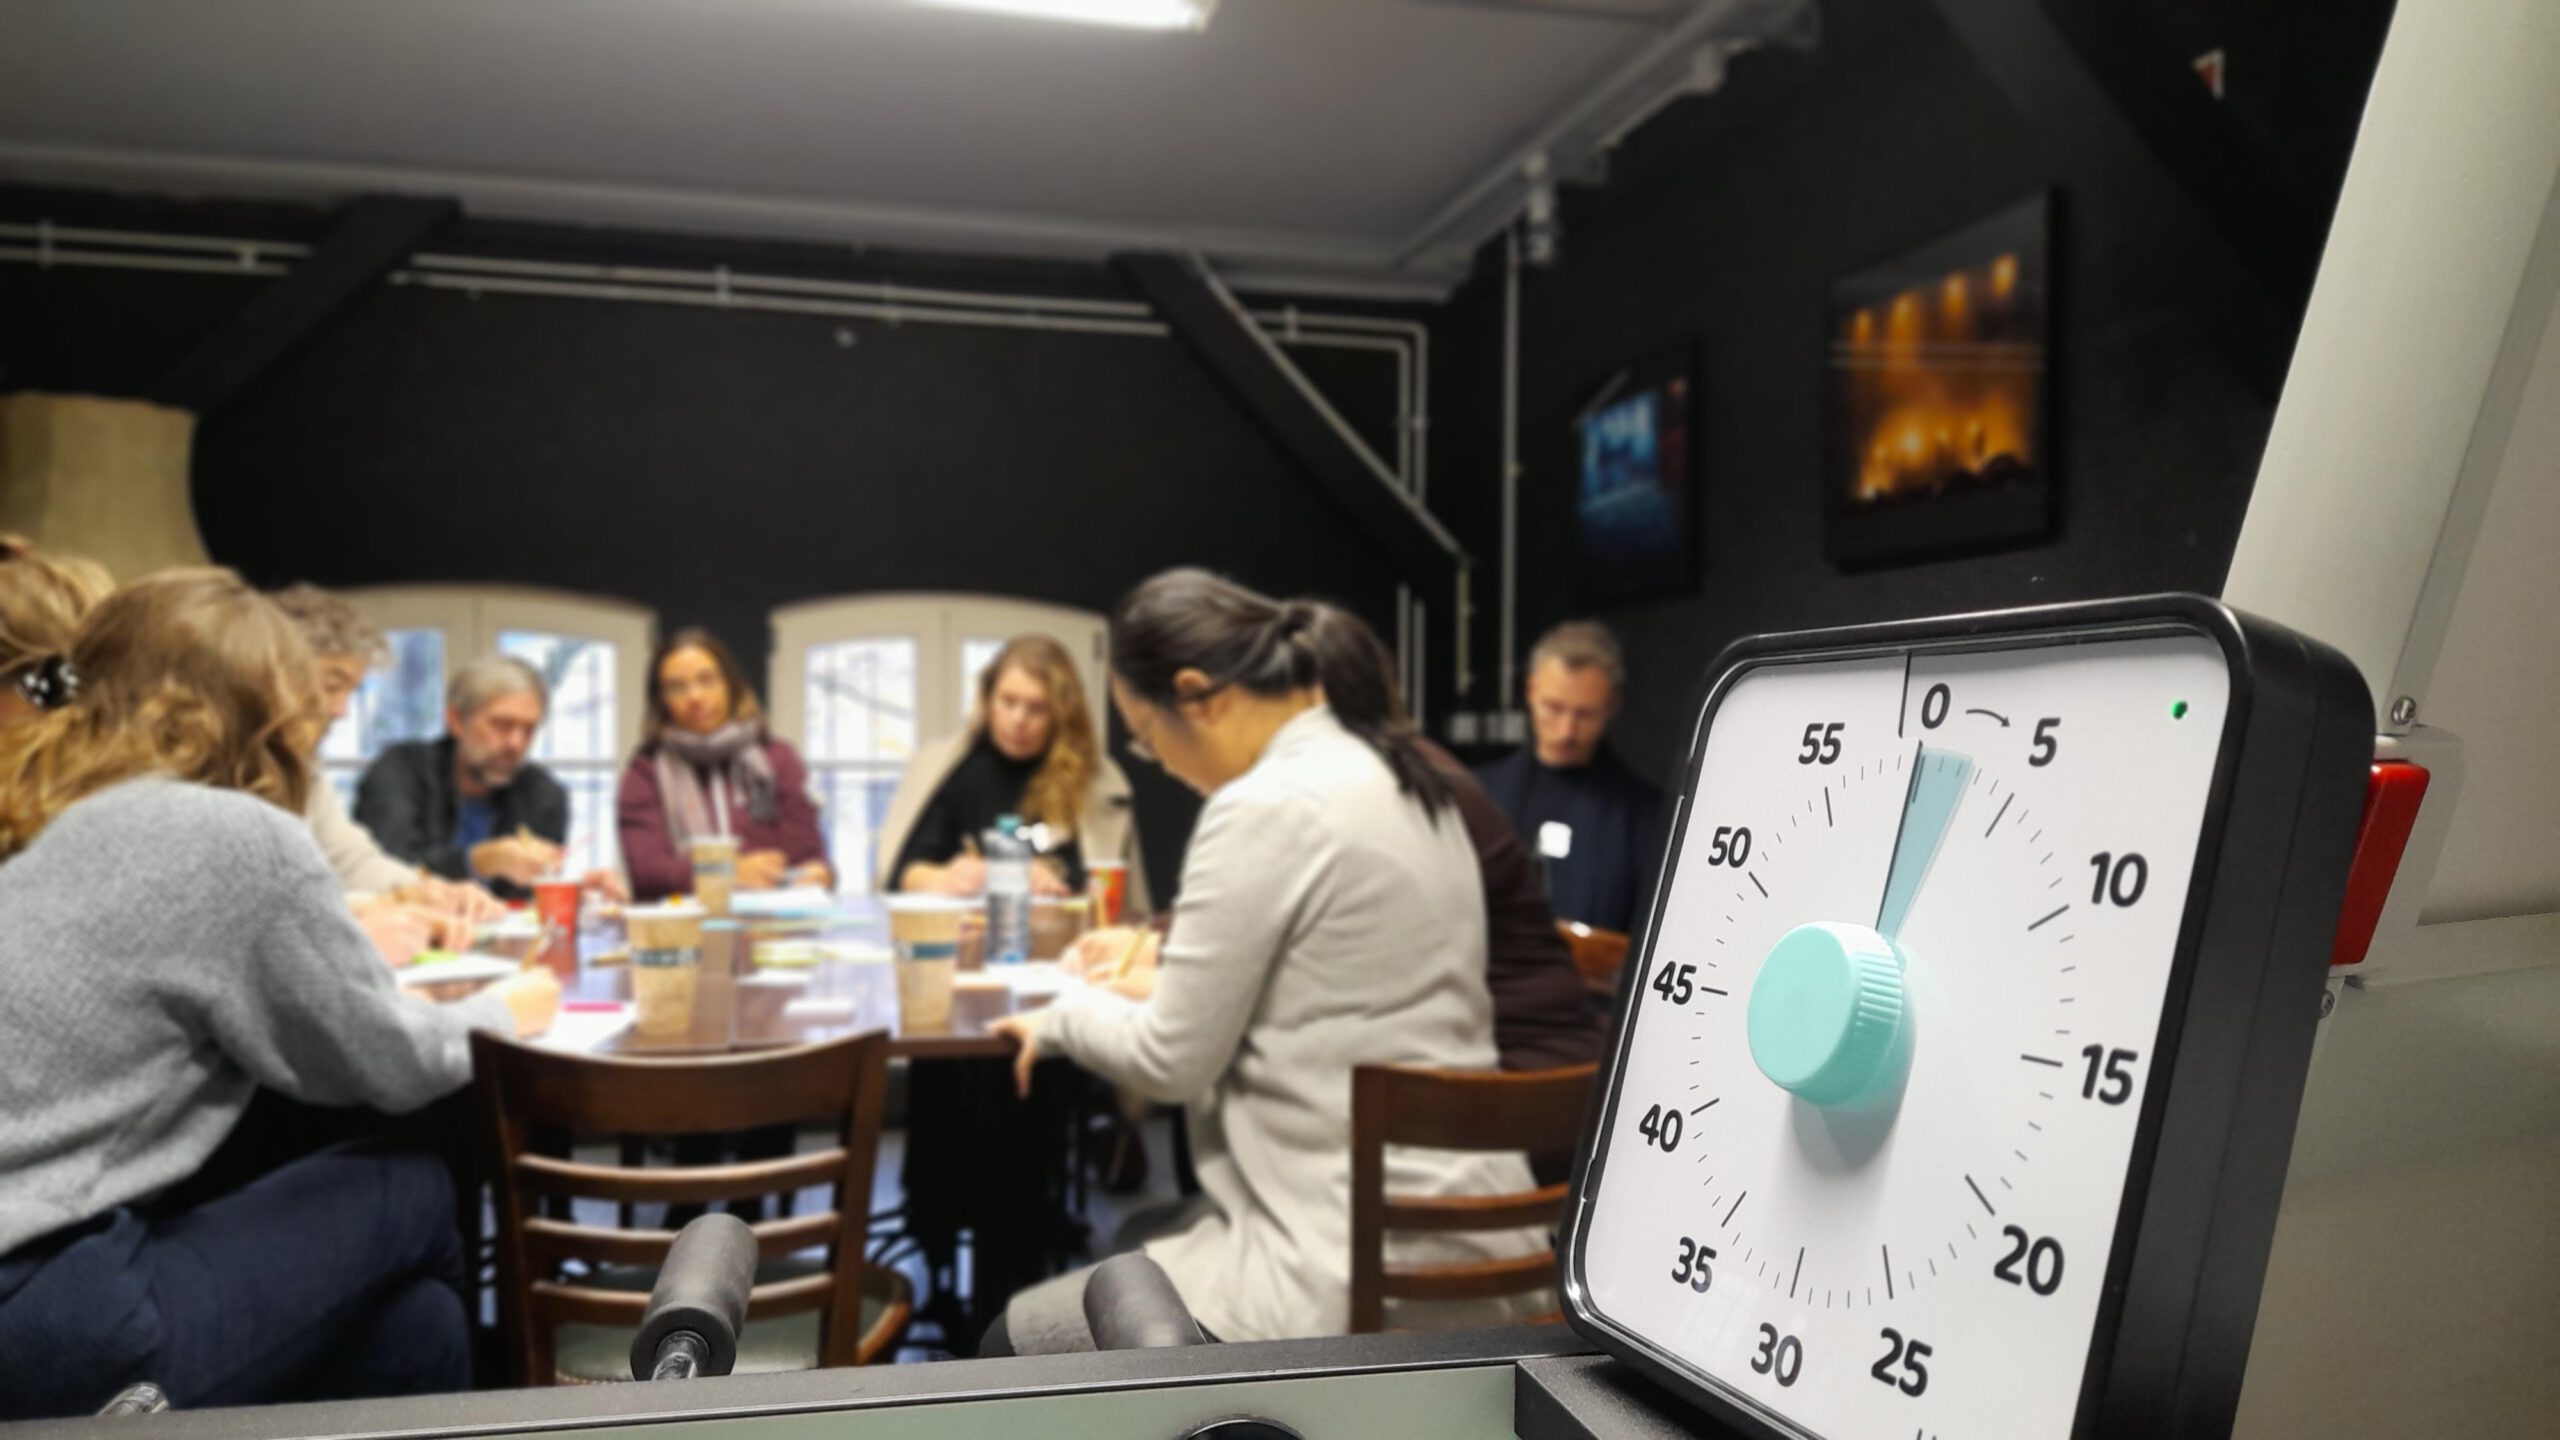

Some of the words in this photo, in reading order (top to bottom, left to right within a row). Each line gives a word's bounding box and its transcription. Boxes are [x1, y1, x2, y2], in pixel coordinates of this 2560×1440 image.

[1921, 683, 1951, 729] 0
[1799, 723, 1844, 764] 55
[2029, 718, 2060, 766] 5
[1708, 827, 1751, 868] 50
[2091, 852, 2147, 907] 10
[1653, 961, 1696, 1005] 45
[2083, 1045, 2137, 1105] 15
[1639, 1104, 1682, 1152] 40
[1672, 1237, 1716, 1292] 35
[1994, 1225, 2064, 1296] 20
[1751, 1323, 1802, 1387] 30
[1871, 1328, 1932, 1397] 25
